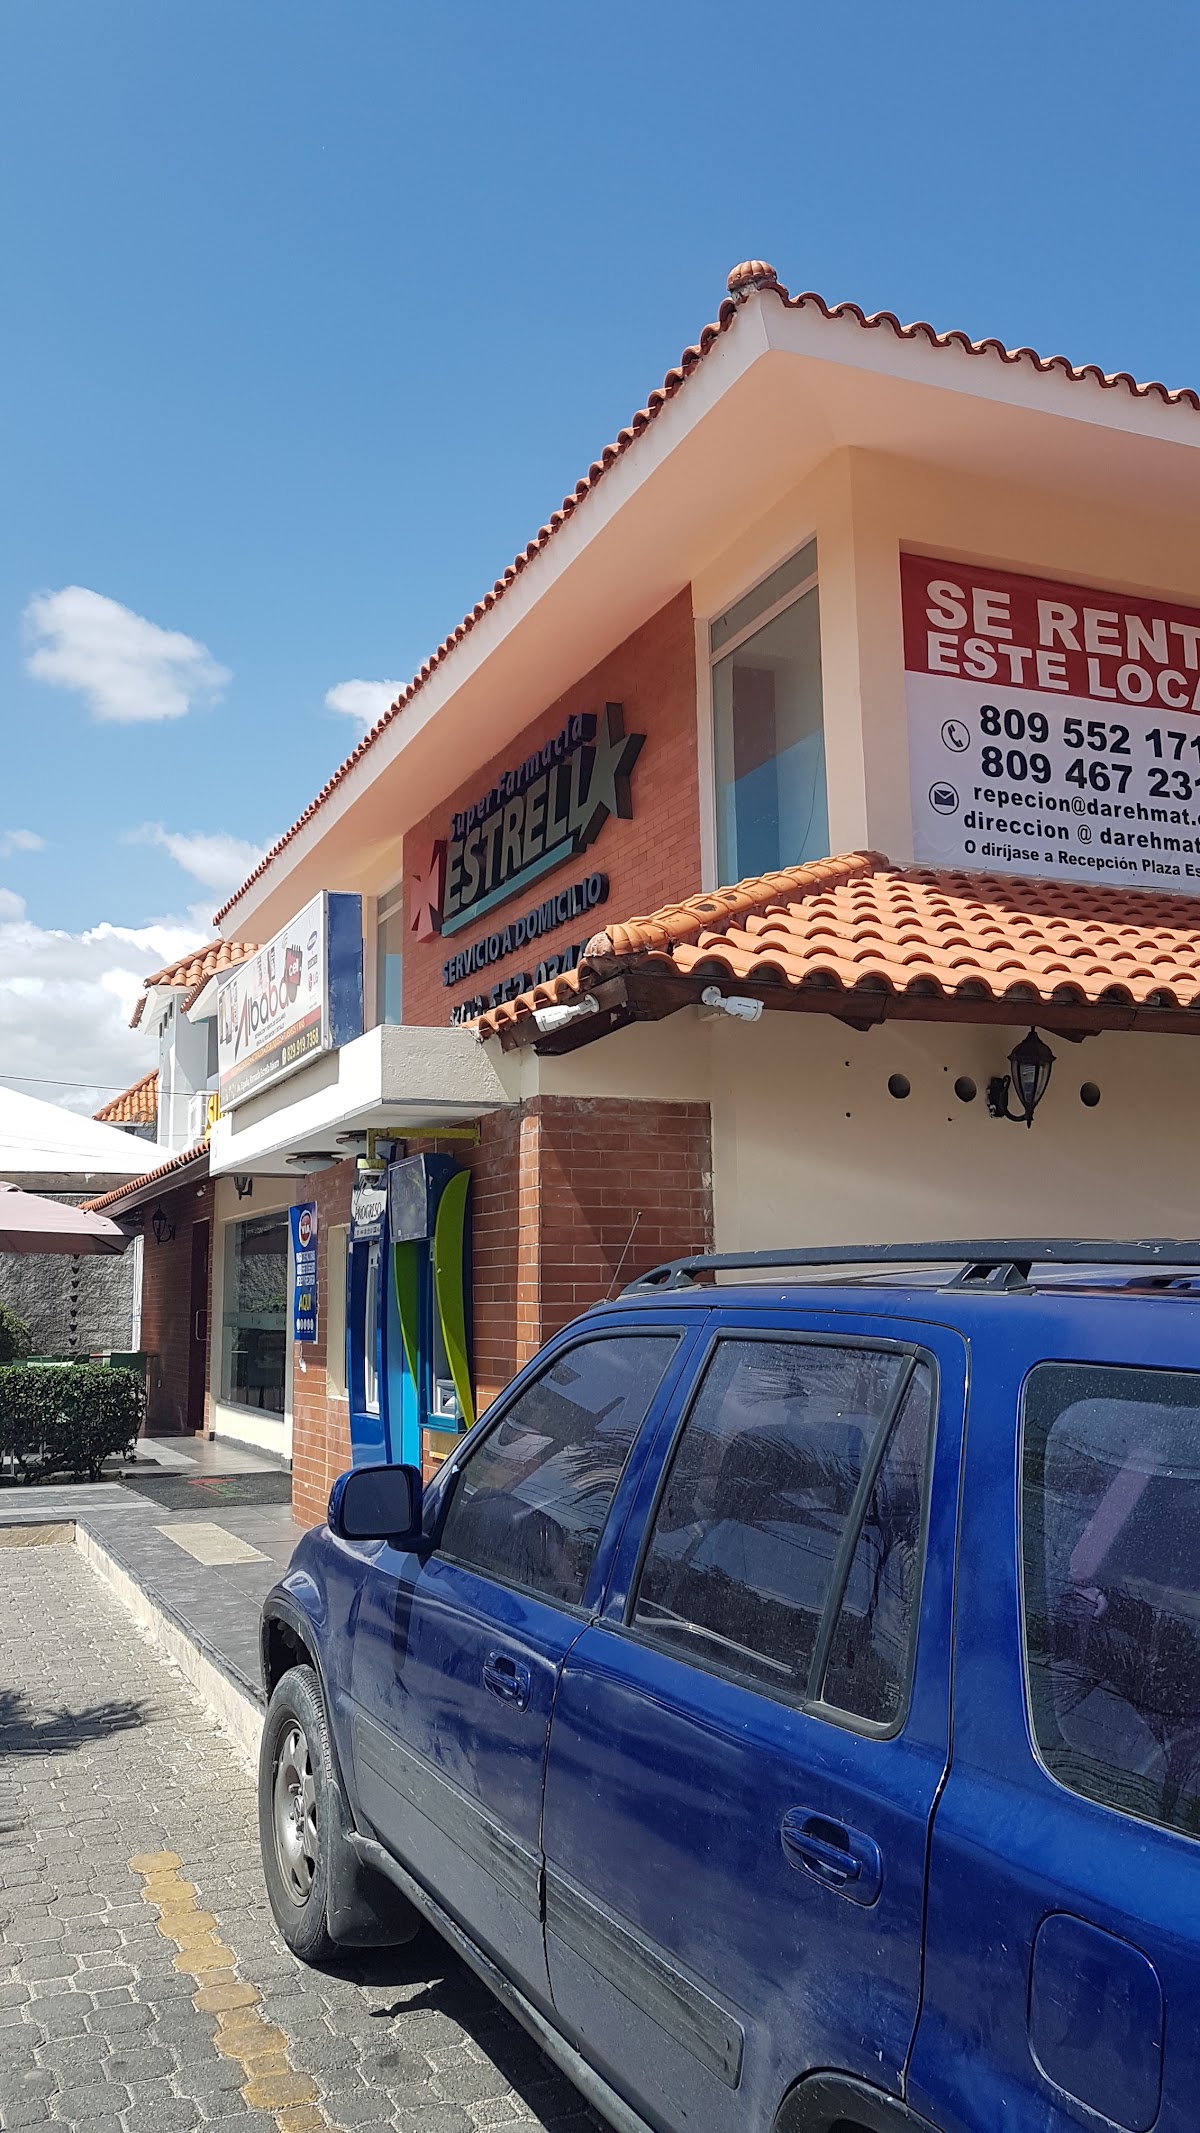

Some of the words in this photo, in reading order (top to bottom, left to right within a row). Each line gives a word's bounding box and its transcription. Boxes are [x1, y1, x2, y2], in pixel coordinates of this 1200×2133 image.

[925, 579, 1013, 641] SE
[1036, 598, 1200, 671] RENT
[926, 630, 1070, 691] ESTE
[979, 704, 1049, 744] 809
[1062, 716, 1132, 755] 552
[981, 745, 1052, 784] 809
[1065, 757, 1133, 794] 467
[963, 810, 1070, 840] direccion
[1077, 823, 1092, 845] @
[973, 786, 1200, 826] repecion@darehmat.
[964, 839, 977, 854] O
[981, 841, 1040, 862] diríjase
[1044, 851, 1054, 863] a
[1058, 850, 1138, 871] Recepción
[1142, 858, 1181, 876] Plaza
[441, 933, 501, 987] SERVICIO
[501, 929, 514, 955] A
[515, 871, 605, 947] DOMICILIO
